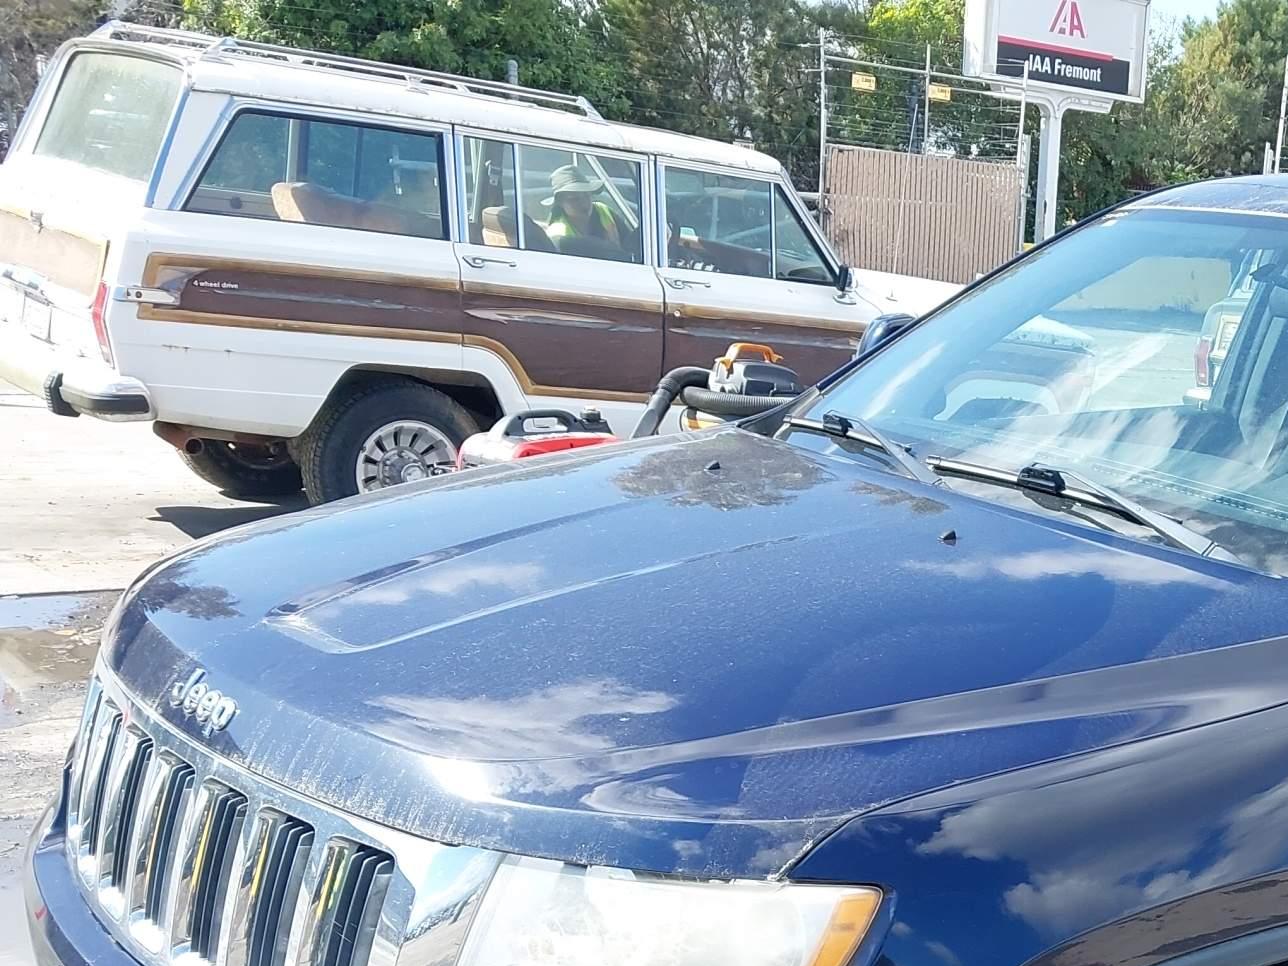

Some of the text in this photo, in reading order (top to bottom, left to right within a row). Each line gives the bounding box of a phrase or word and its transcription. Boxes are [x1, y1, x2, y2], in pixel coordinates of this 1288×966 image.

[1029, 54, 1102, 83] IAA Fremont
[169, 668, 241, 738] Jeep
